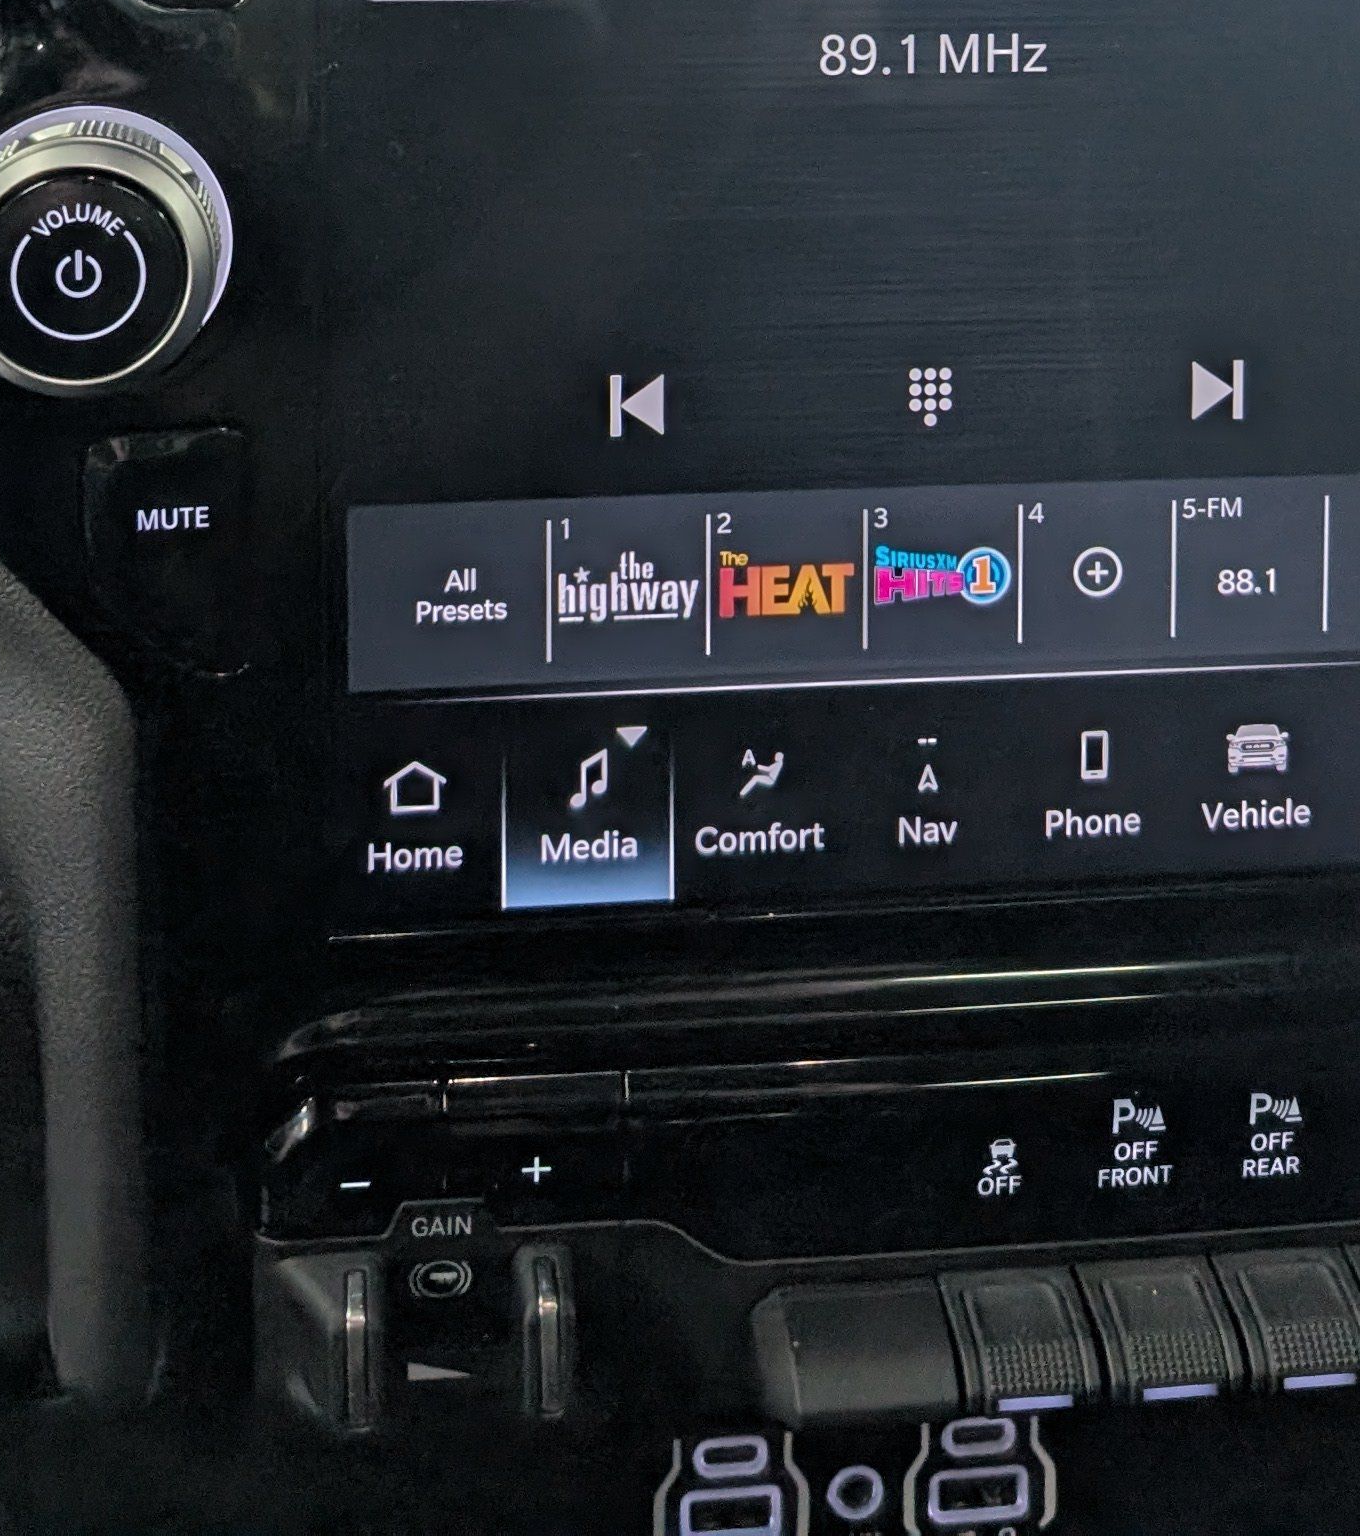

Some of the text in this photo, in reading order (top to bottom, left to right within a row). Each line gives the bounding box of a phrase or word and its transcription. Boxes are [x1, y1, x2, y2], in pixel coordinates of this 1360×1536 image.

[819, 34, 1048, 76] 89.1 MHz
[31, 202, 126, 238] VOLUME
[136, 505, 210, 532] MUTE
[873, 507, 889, 529] 3
[1027, 502, 1044, 525] 4
[1182, 497, 1243, 520] 5-FM
[560, 517, 570, 539] 1
[717, 512, 732, 534] 2
[619, 550, 654, 580] the
[719, 550, 749, 567] The
[444, 567, 476, 594] All
[719, 563, 854, 618] HEAT
[874, 565, 965, 605] HITS
[1217, 568, 1278, 595] 88.1
[558, 569, 699, 622] highway
[415, 597, 508, 625] Presets
[1045, 808, 1141, 838] Phone
[1201, 798, 1311, 831] Vehicle
[695, 821, 825, 856] Comfort
[898, 816, 958, 846] Nav
[367, 841, 463, 875] Home
[540, 830, 638, 864] Media
[1113, 1141, 1158, 1162] OFF
[1250, 1131, 1294, 1152] OFF
[1098, 1164, 1172, 1188] FRONT
[1242, 1155, 1300, 1178] REAR
[977, 1175, 1022, 1197] OFF
[411, 1214, 472, 1237] GAIN
